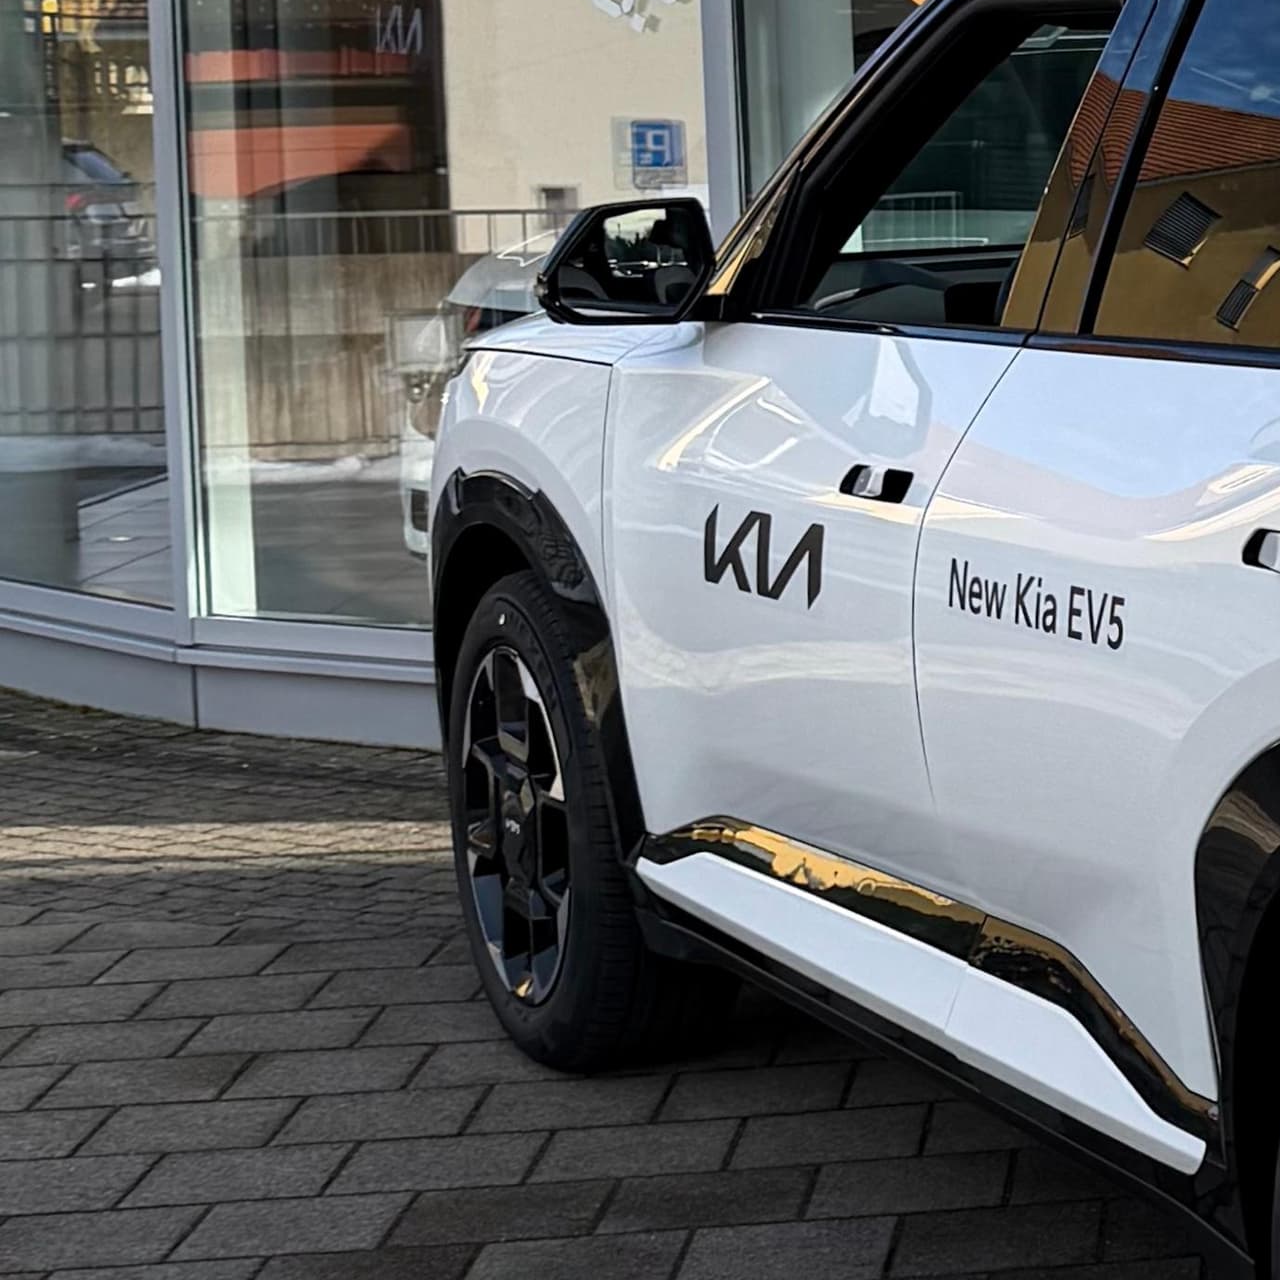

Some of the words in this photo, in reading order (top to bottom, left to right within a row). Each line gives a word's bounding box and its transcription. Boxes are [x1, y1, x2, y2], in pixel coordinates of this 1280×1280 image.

[702, 503, 825, 610] KIA
[948, 557, 1007, 623] New
[1015, 572, 1058, 635] Kia
[1068, 585, 1126, 651] EV5
